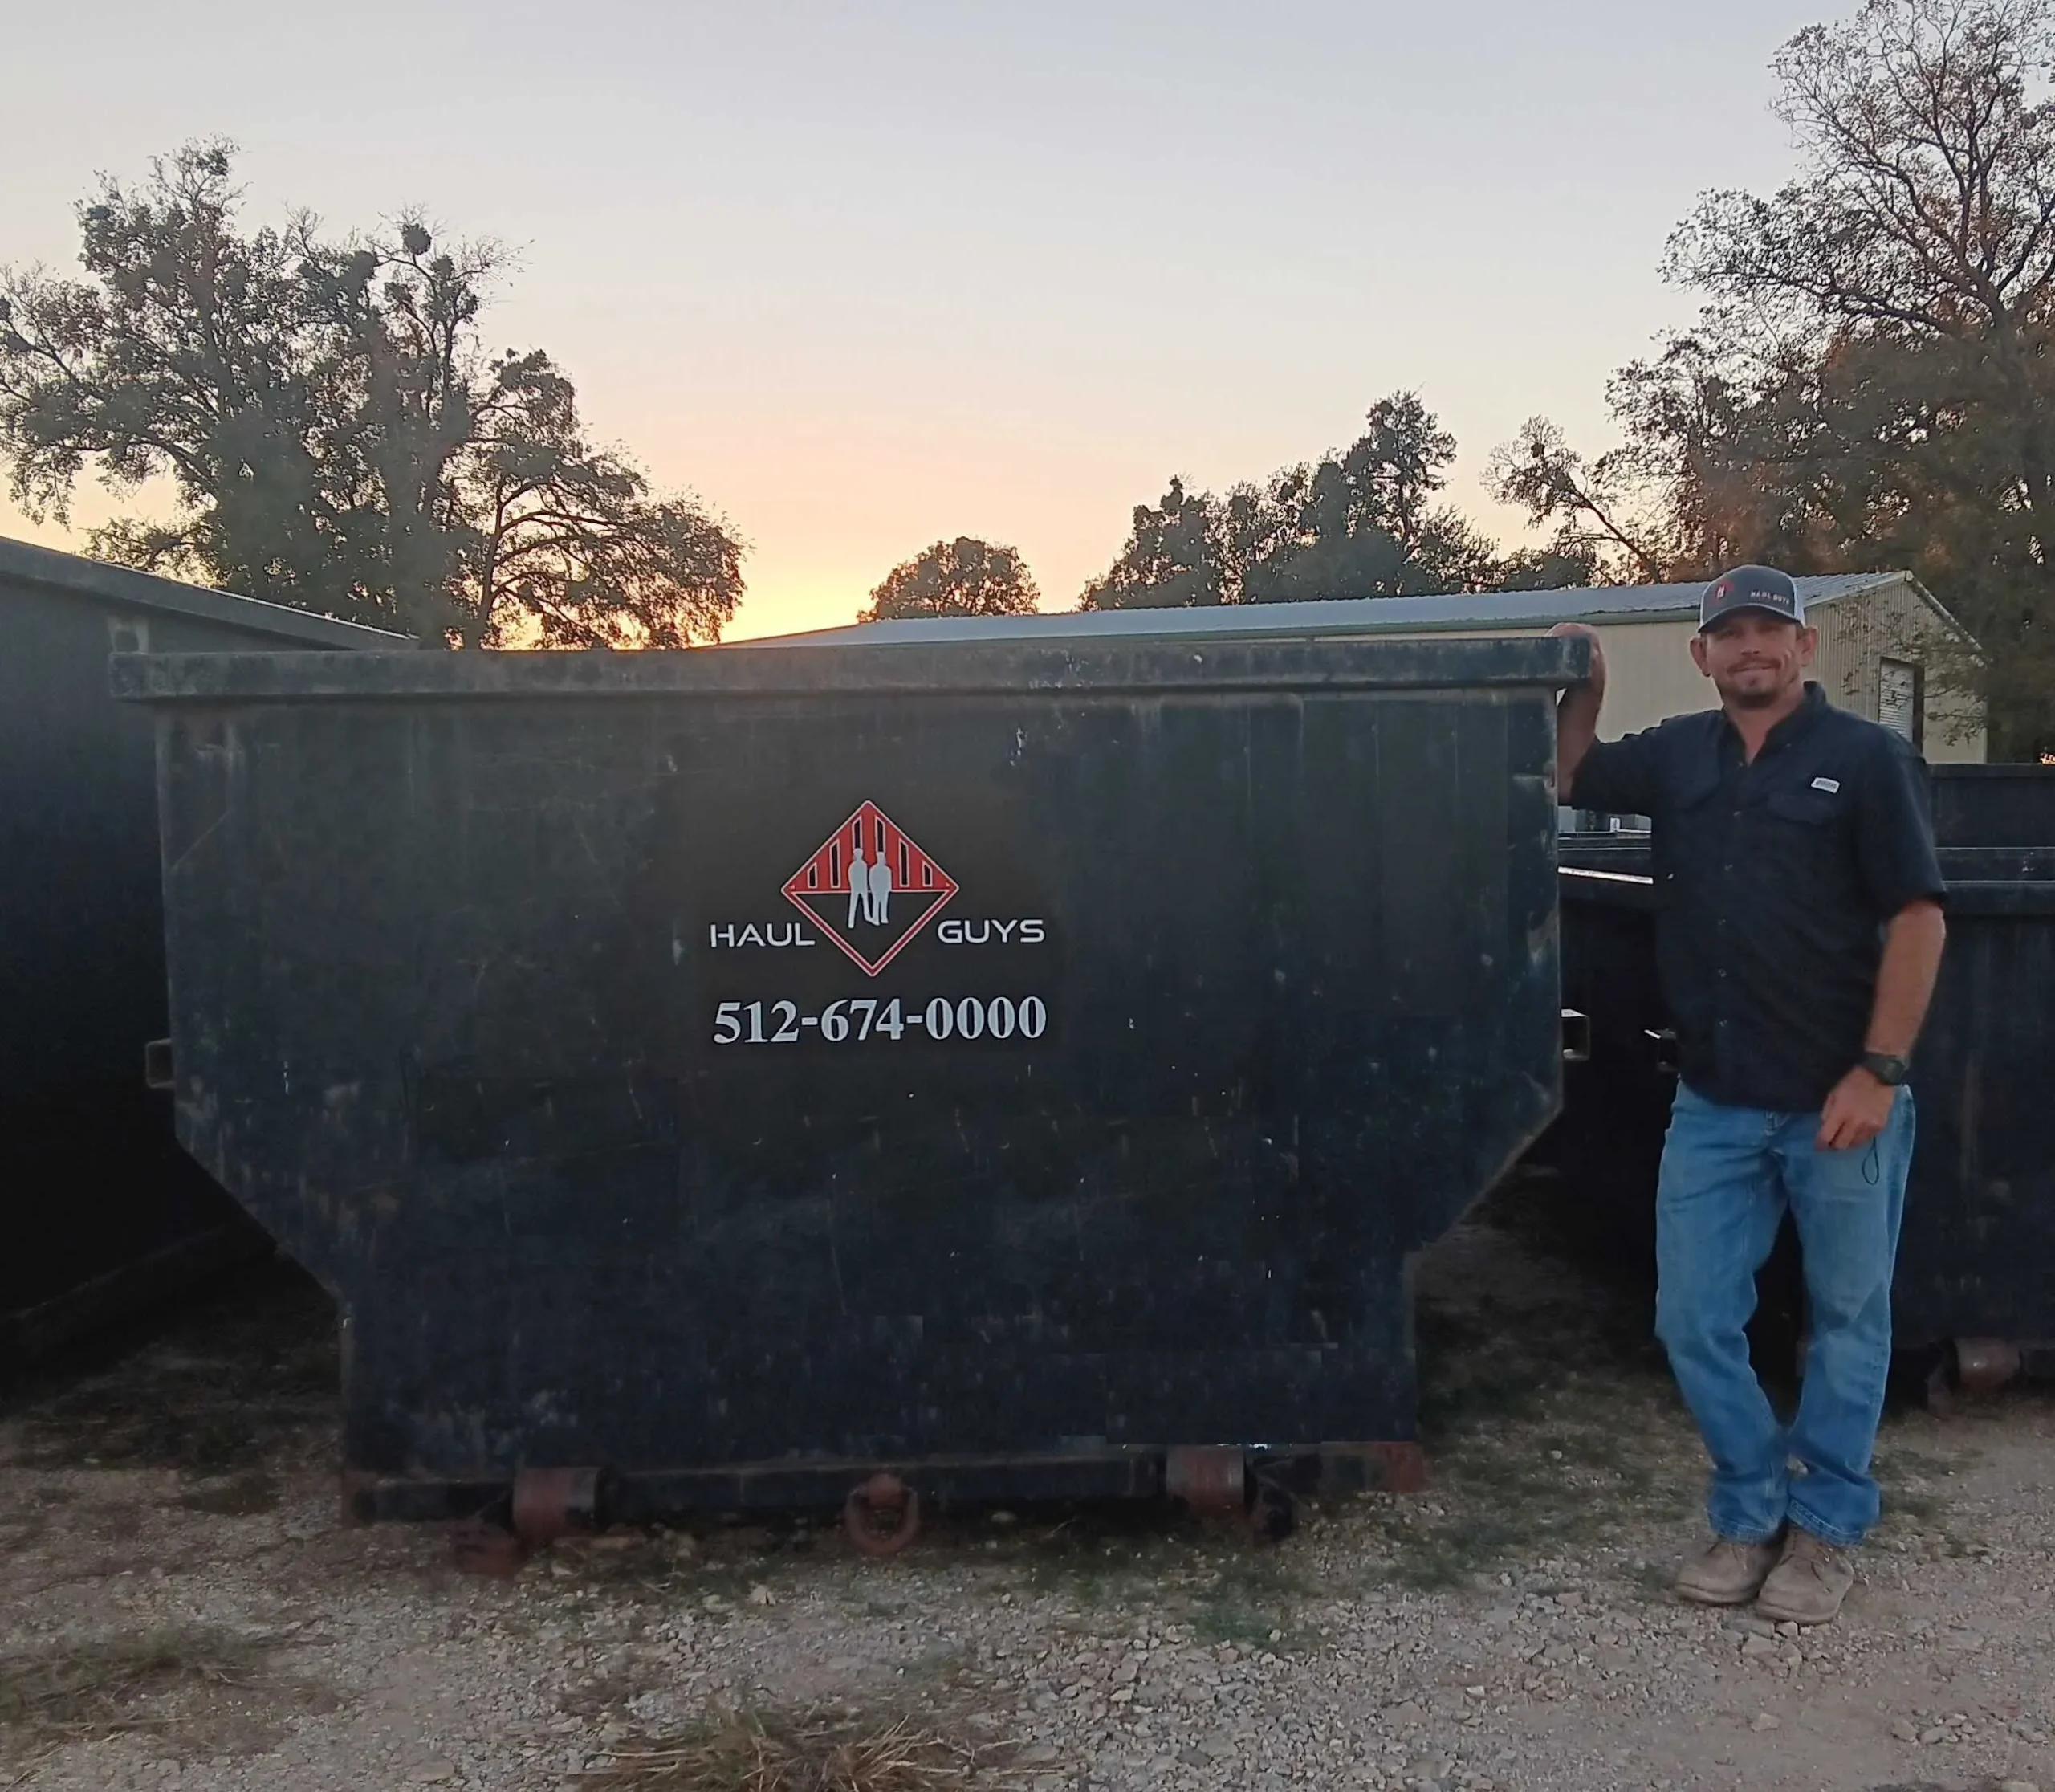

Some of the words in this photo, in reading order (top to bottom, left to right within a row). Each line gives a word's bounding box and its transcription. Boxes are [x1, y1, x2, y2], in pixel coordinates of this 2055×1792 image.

[710, 922, 816, 948] HAUL
[937, 919, 1045, 943] GUYS
[714, 996, 1047, 1044] 512-674-0000
